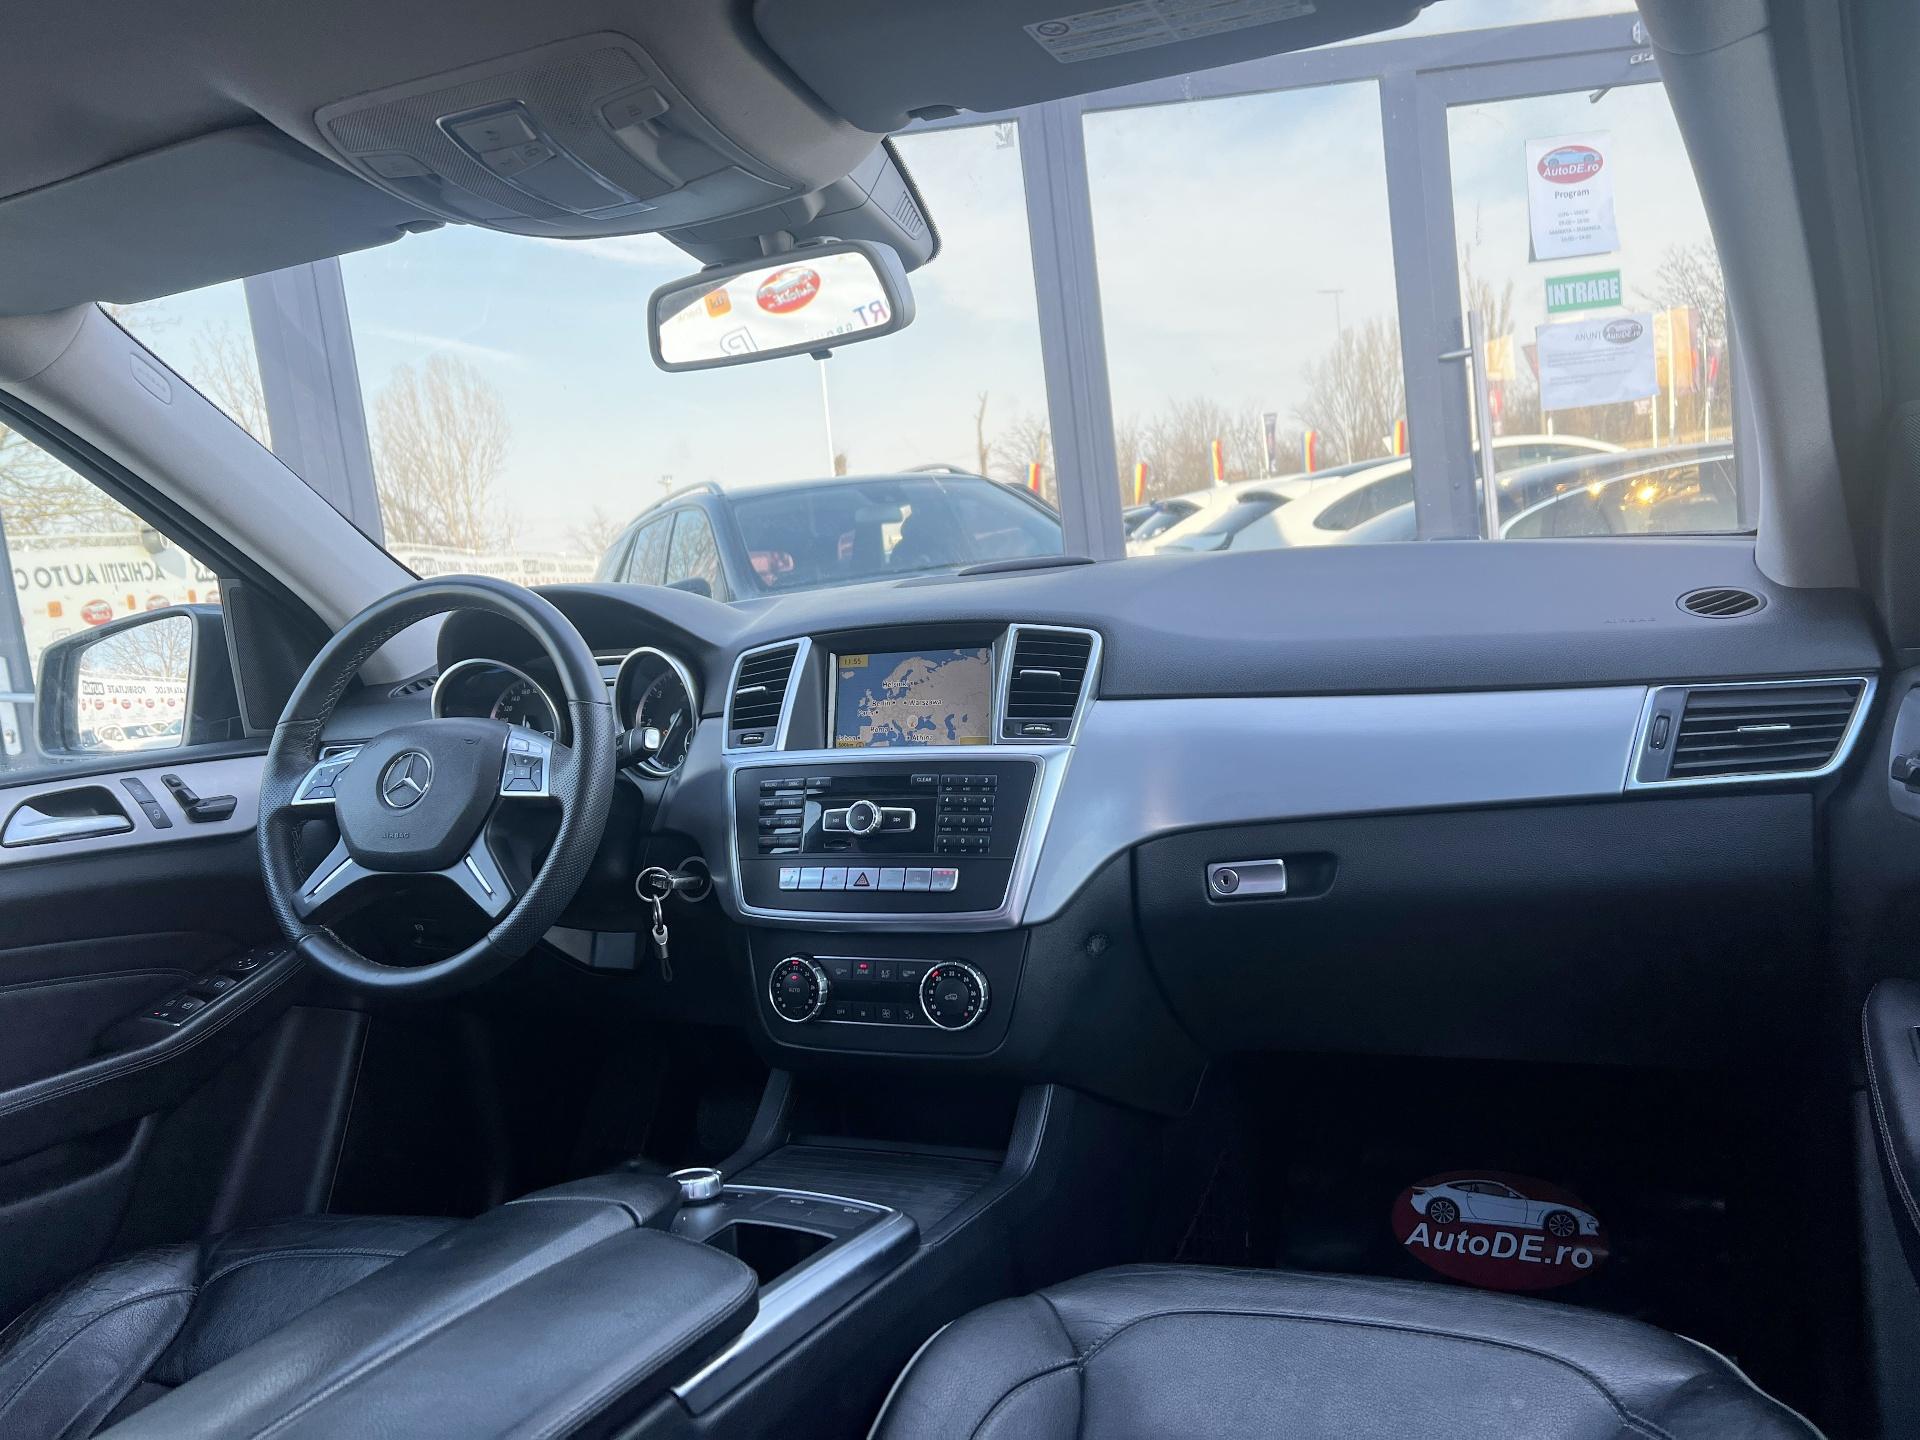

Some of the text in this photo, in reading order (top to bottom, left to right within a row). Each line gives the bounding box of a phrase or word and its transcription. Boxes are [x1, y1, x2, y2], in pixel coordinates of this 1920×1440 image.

[1543, 163, 1600, 177] AutoDE.ro
[1554, 189, 1590, 200] Program
[1548, 278, 1619, 306] INTRARE
[909, 699, 943, 707] Warszawa
[1404, 1222, 1594, 1269] AutoDE.ro
